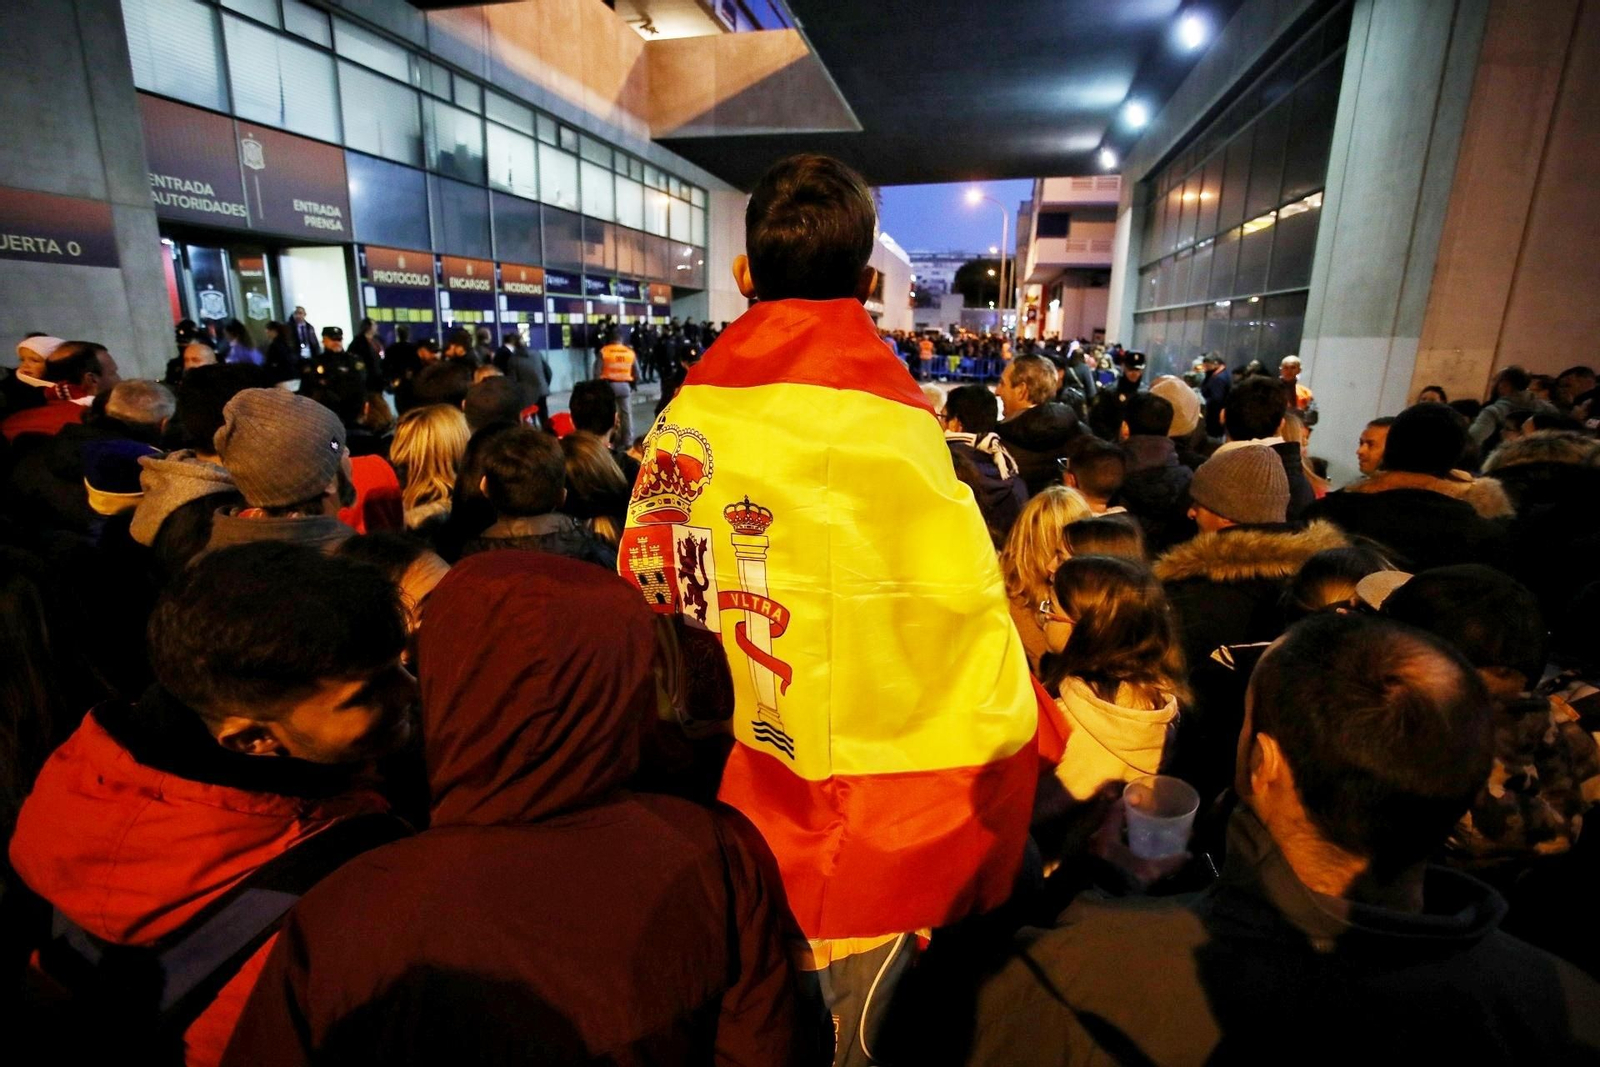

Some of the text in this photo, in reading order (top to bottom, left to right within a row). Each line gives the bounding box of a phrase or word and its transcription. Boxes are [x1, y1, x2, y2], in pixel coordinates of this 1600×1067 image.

[147, 172, 215, 197] ENTRADA
[151, 190, 248, 218] AUTORIDADES
[293, 198, 342, 218] ENTRADA
[304, 216, 344, 231] PRENSA
[372, 269, 431, 287] PROTOCOLO
[449, 276, 491, 292] ENCARGOS
[504, 281, 543, 296] INCIDENCIAS
[730, 593, 783, 621] VLTRA
